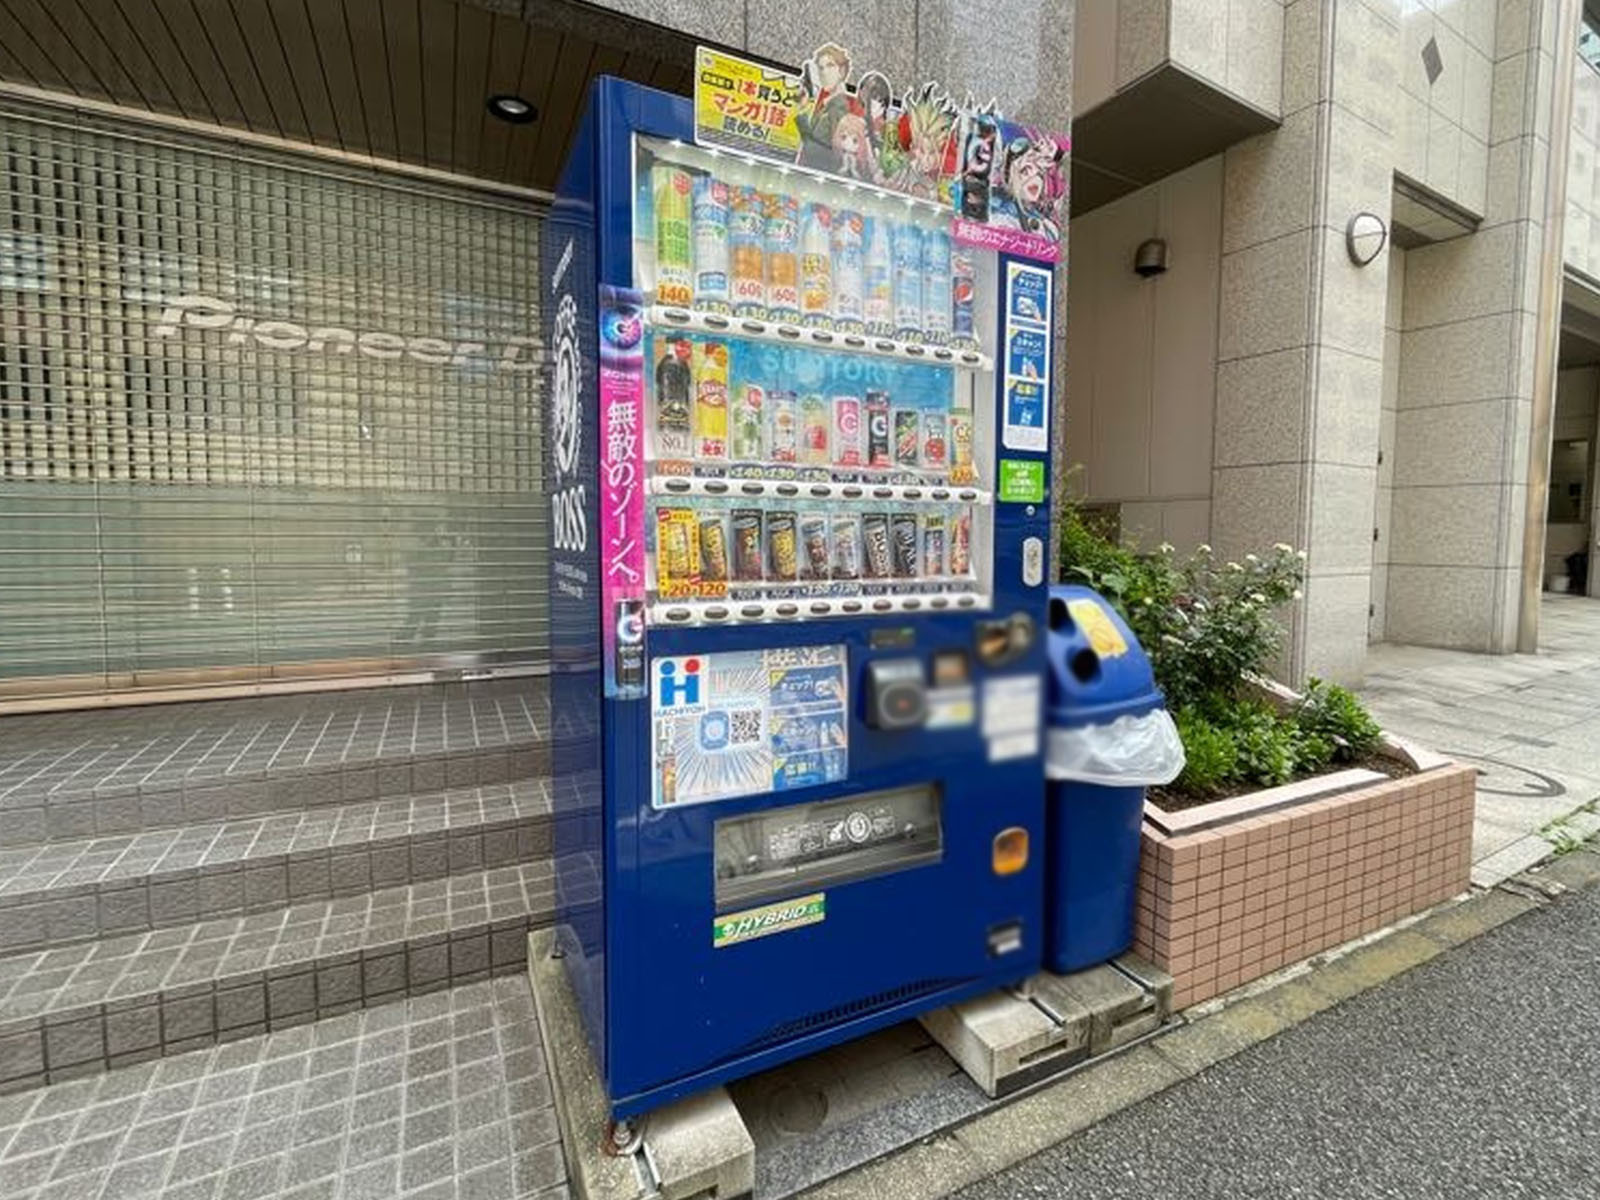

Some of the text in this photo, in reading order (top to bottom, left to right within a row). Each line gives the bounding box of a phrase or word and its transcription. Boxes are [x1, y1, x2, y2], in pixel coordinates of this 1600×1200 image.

[713, 92, 788, 128] マンガ1話
[154, 293, 486, 366] Pioneer
[735, 904, 807, 938] HYBRID
